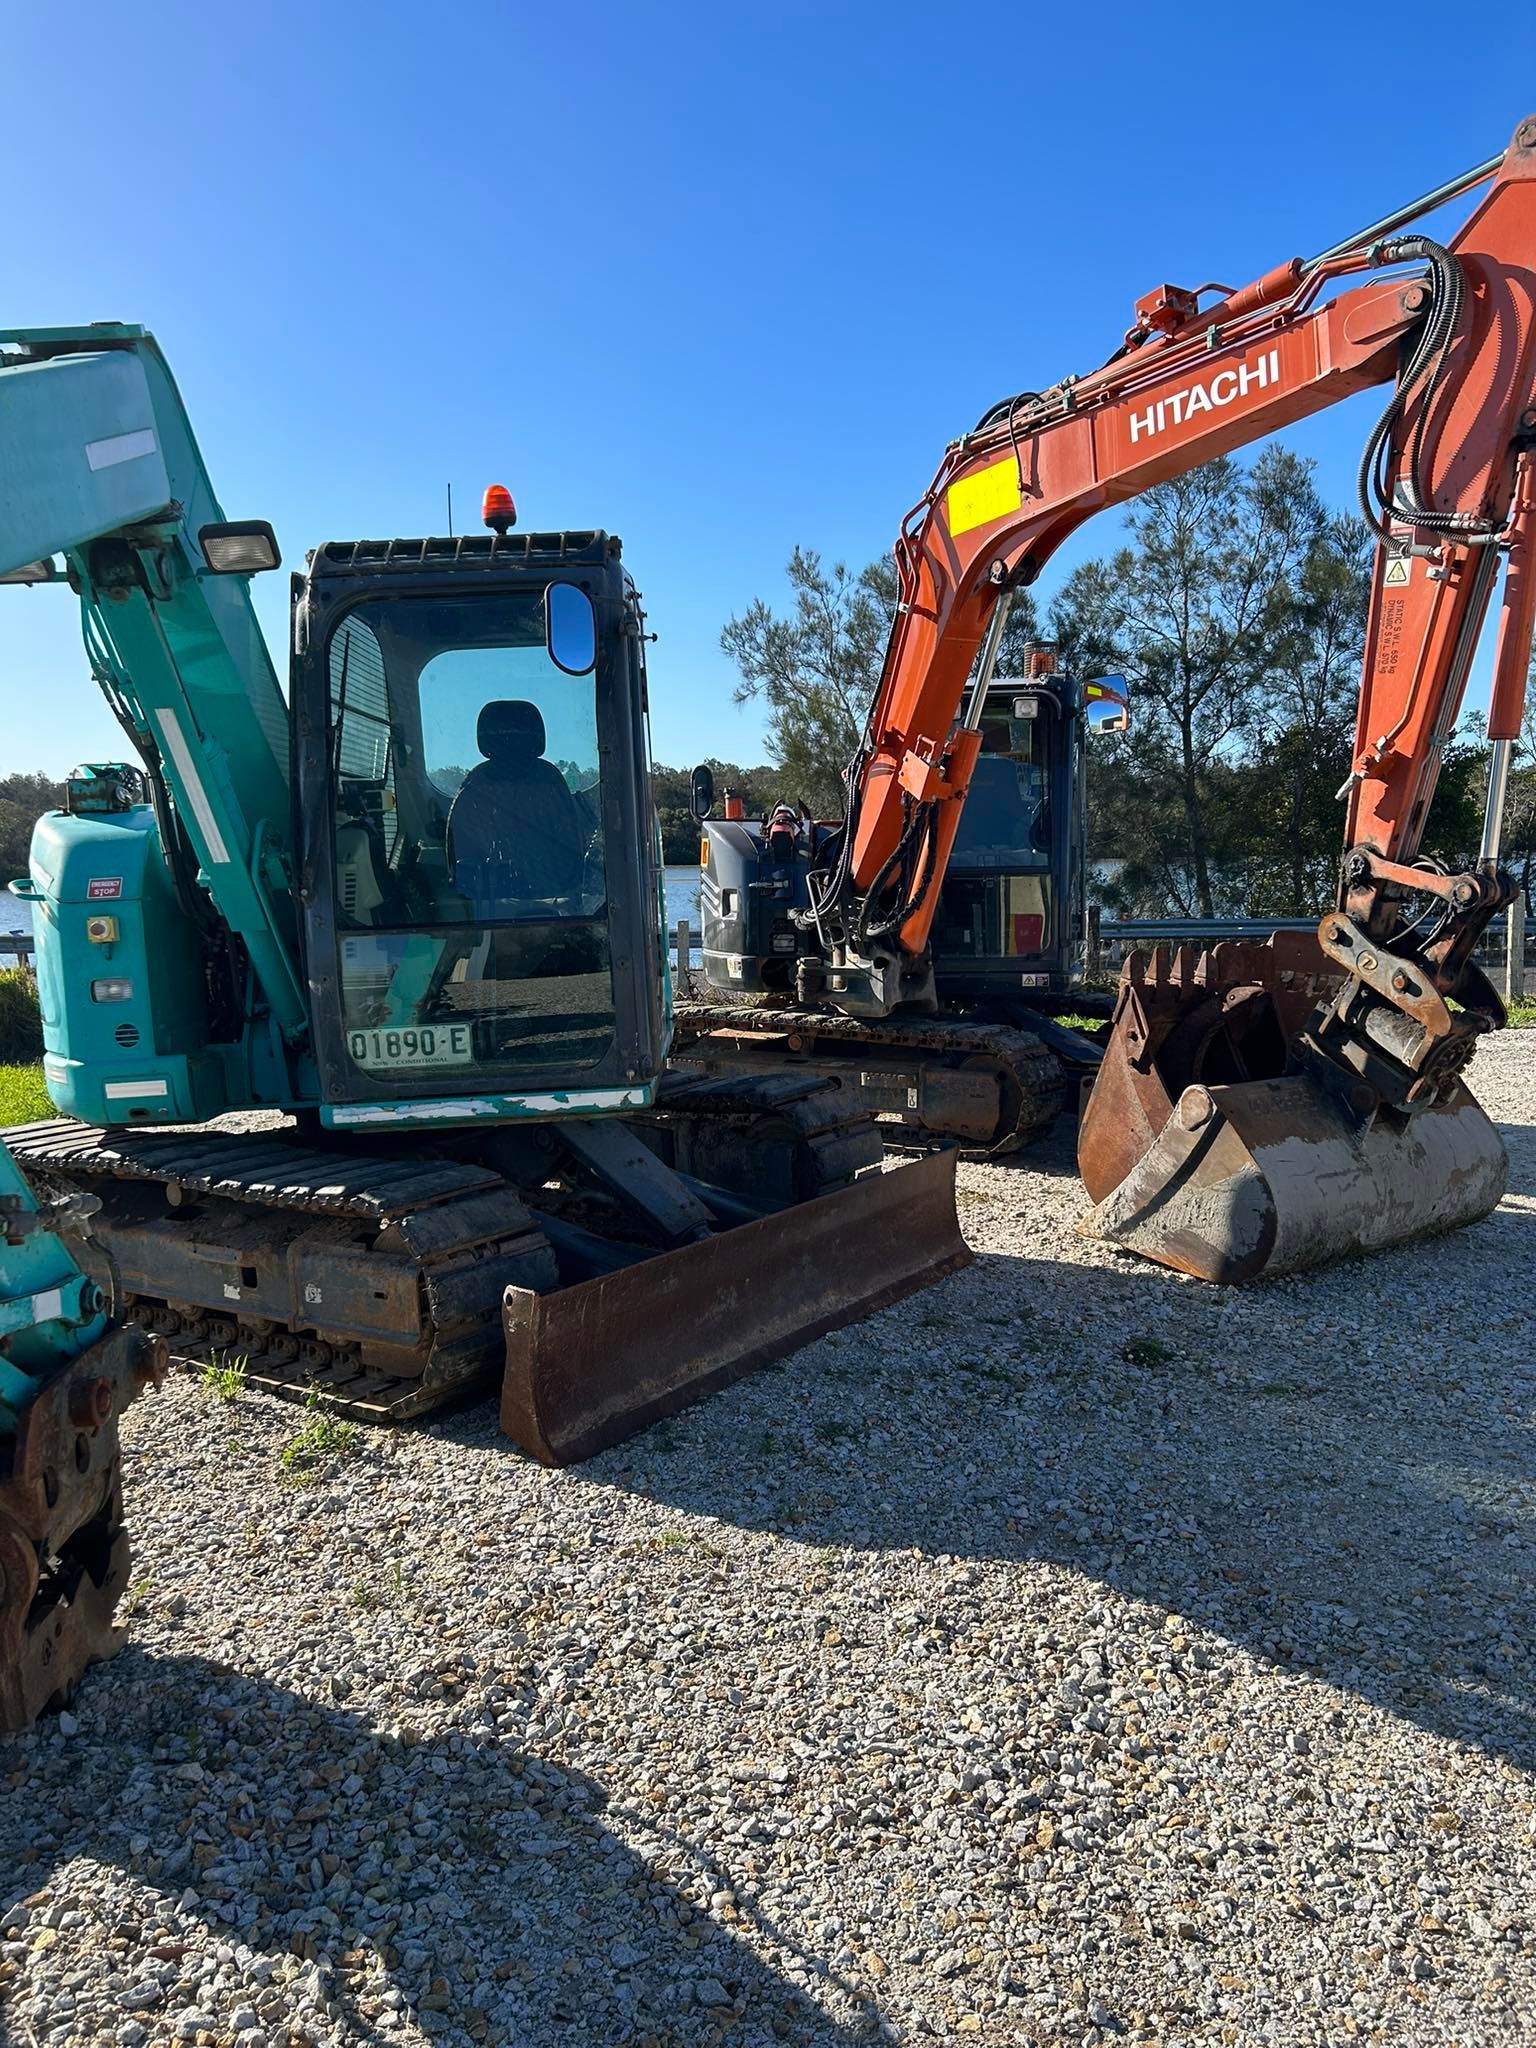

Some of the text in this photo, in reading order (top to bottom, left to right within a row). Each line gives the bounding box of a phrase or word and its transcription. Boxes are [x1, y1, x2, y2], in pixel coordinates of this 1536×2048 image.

[1129, 350, 1279, 444] HITACHI
[1385, 600, 1396, 629] DYNAMIC
[1395, 600, 1404, 624] STATIC
[94, 888, 116, 896] STOP
[396, 1057, 448, 1065] CONDITIONAL
